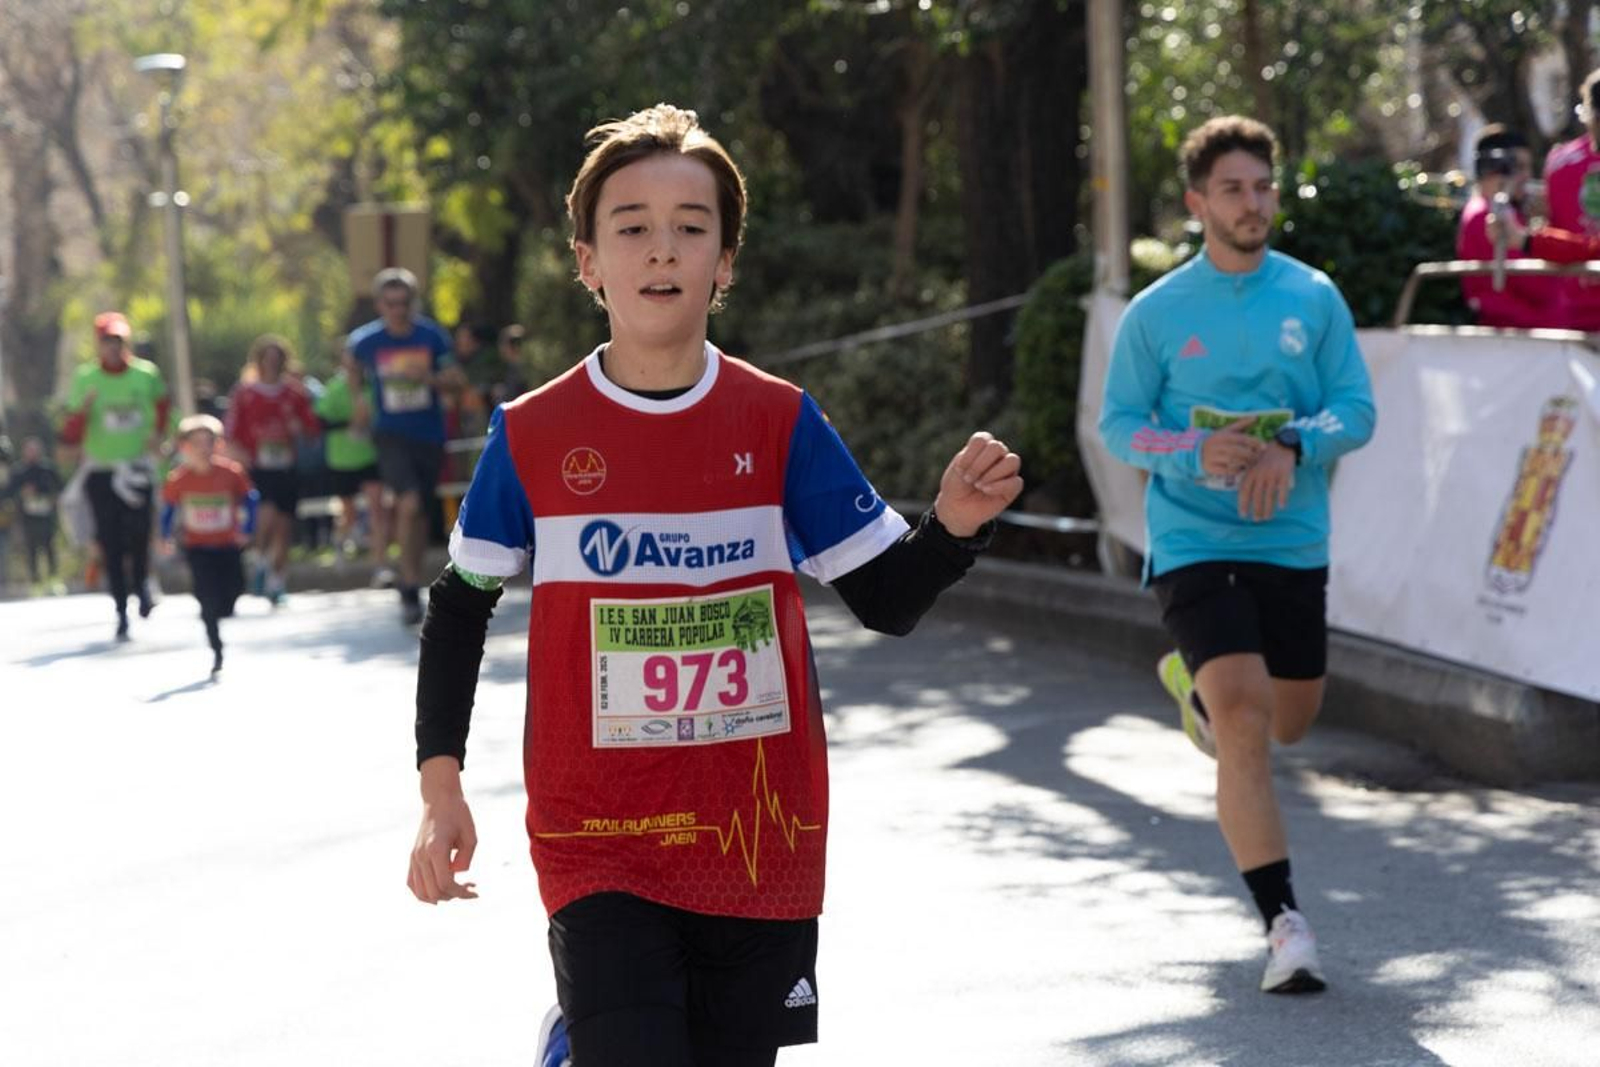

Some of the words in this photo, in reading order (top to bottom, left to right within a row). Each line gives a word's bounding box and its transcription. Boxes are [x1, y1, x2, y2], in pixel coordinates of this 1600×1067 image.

[634, 532, 755, 569] Avanza
[659, 533, 690, 544] GRUPO
[599, 607, 628, 626] I.E.S.
[632, 607, 657, 625] SAN
[661, 604, 696, 625] JUAN
[700, 601, 731, 622] BOSCO
[609, 627, 621, 644] IV
[624, 627, 676, 648] CARRERA
[679, 622, 725, 646] POPULAR
[643, 649, 749, 712] 973
[581, 811, 696, 832] TRAILRUNNERS
[660, 832, 698, 846] JAEN
